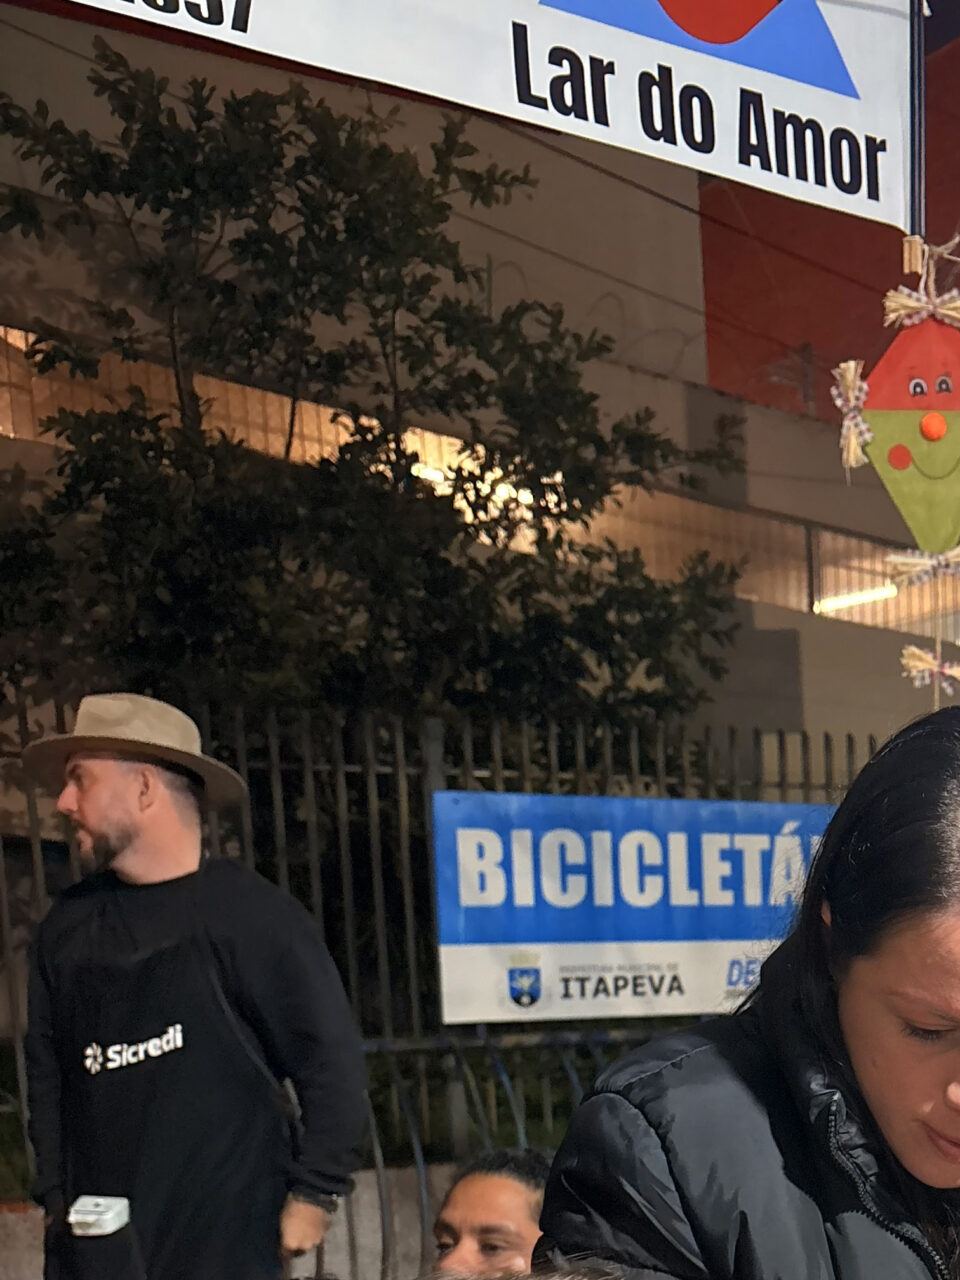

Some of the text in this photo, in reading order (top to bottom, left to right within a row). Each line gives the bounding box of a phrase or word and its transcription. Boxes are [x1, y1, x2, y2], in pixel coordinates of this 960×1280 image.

[510, 21, 888, 202] Lar do Amor
[456, 820, 820, 908] BICICLETÁ
[560, 975, 684, 999] ITAPEVA
[106, 1023, 184, 1070] Sicredi
